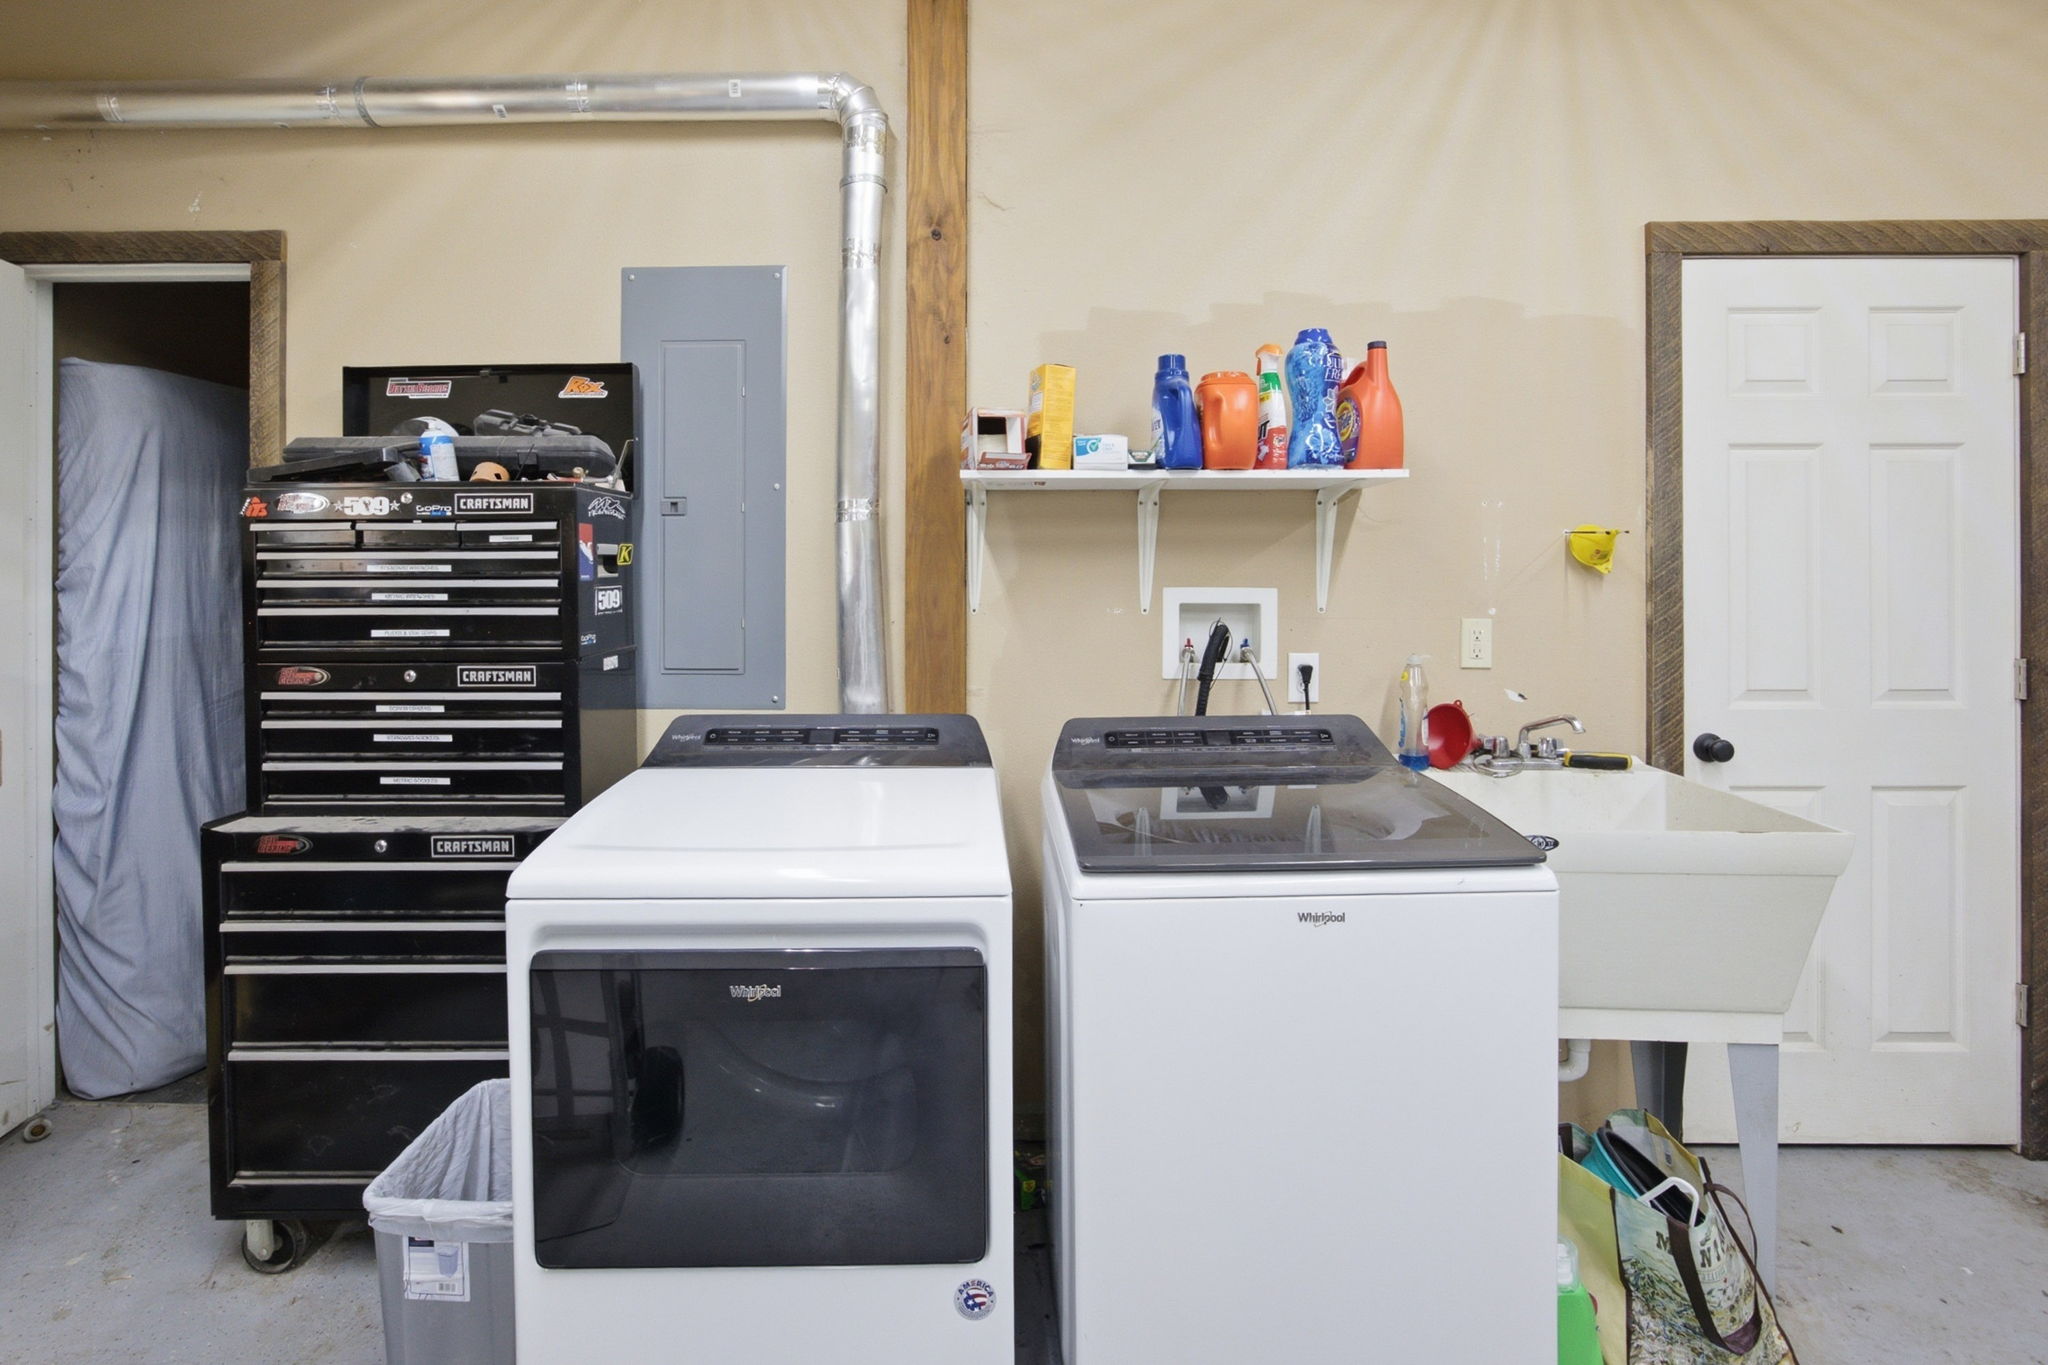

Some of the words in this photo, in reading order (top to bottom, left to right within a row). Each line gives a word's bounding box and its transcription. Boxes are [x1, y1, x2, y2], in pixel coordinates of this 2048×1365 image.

[343, 497, 390, 516] 509
[416, 504, 452, 512] GoPro
[460, 498, 529, 509] CRAFTSMAN
[598, 589, 620, 610] 509
[462, 671, 532, 682] CRAFTSMAN
[436, 841, 509, 852] CRAFTSMAN
[1297, 911, 1345, 928] Whirlpool
[729, 984, 781, 1002] Whirlpool
[958, 1280, 994, 1297] AMERICA
